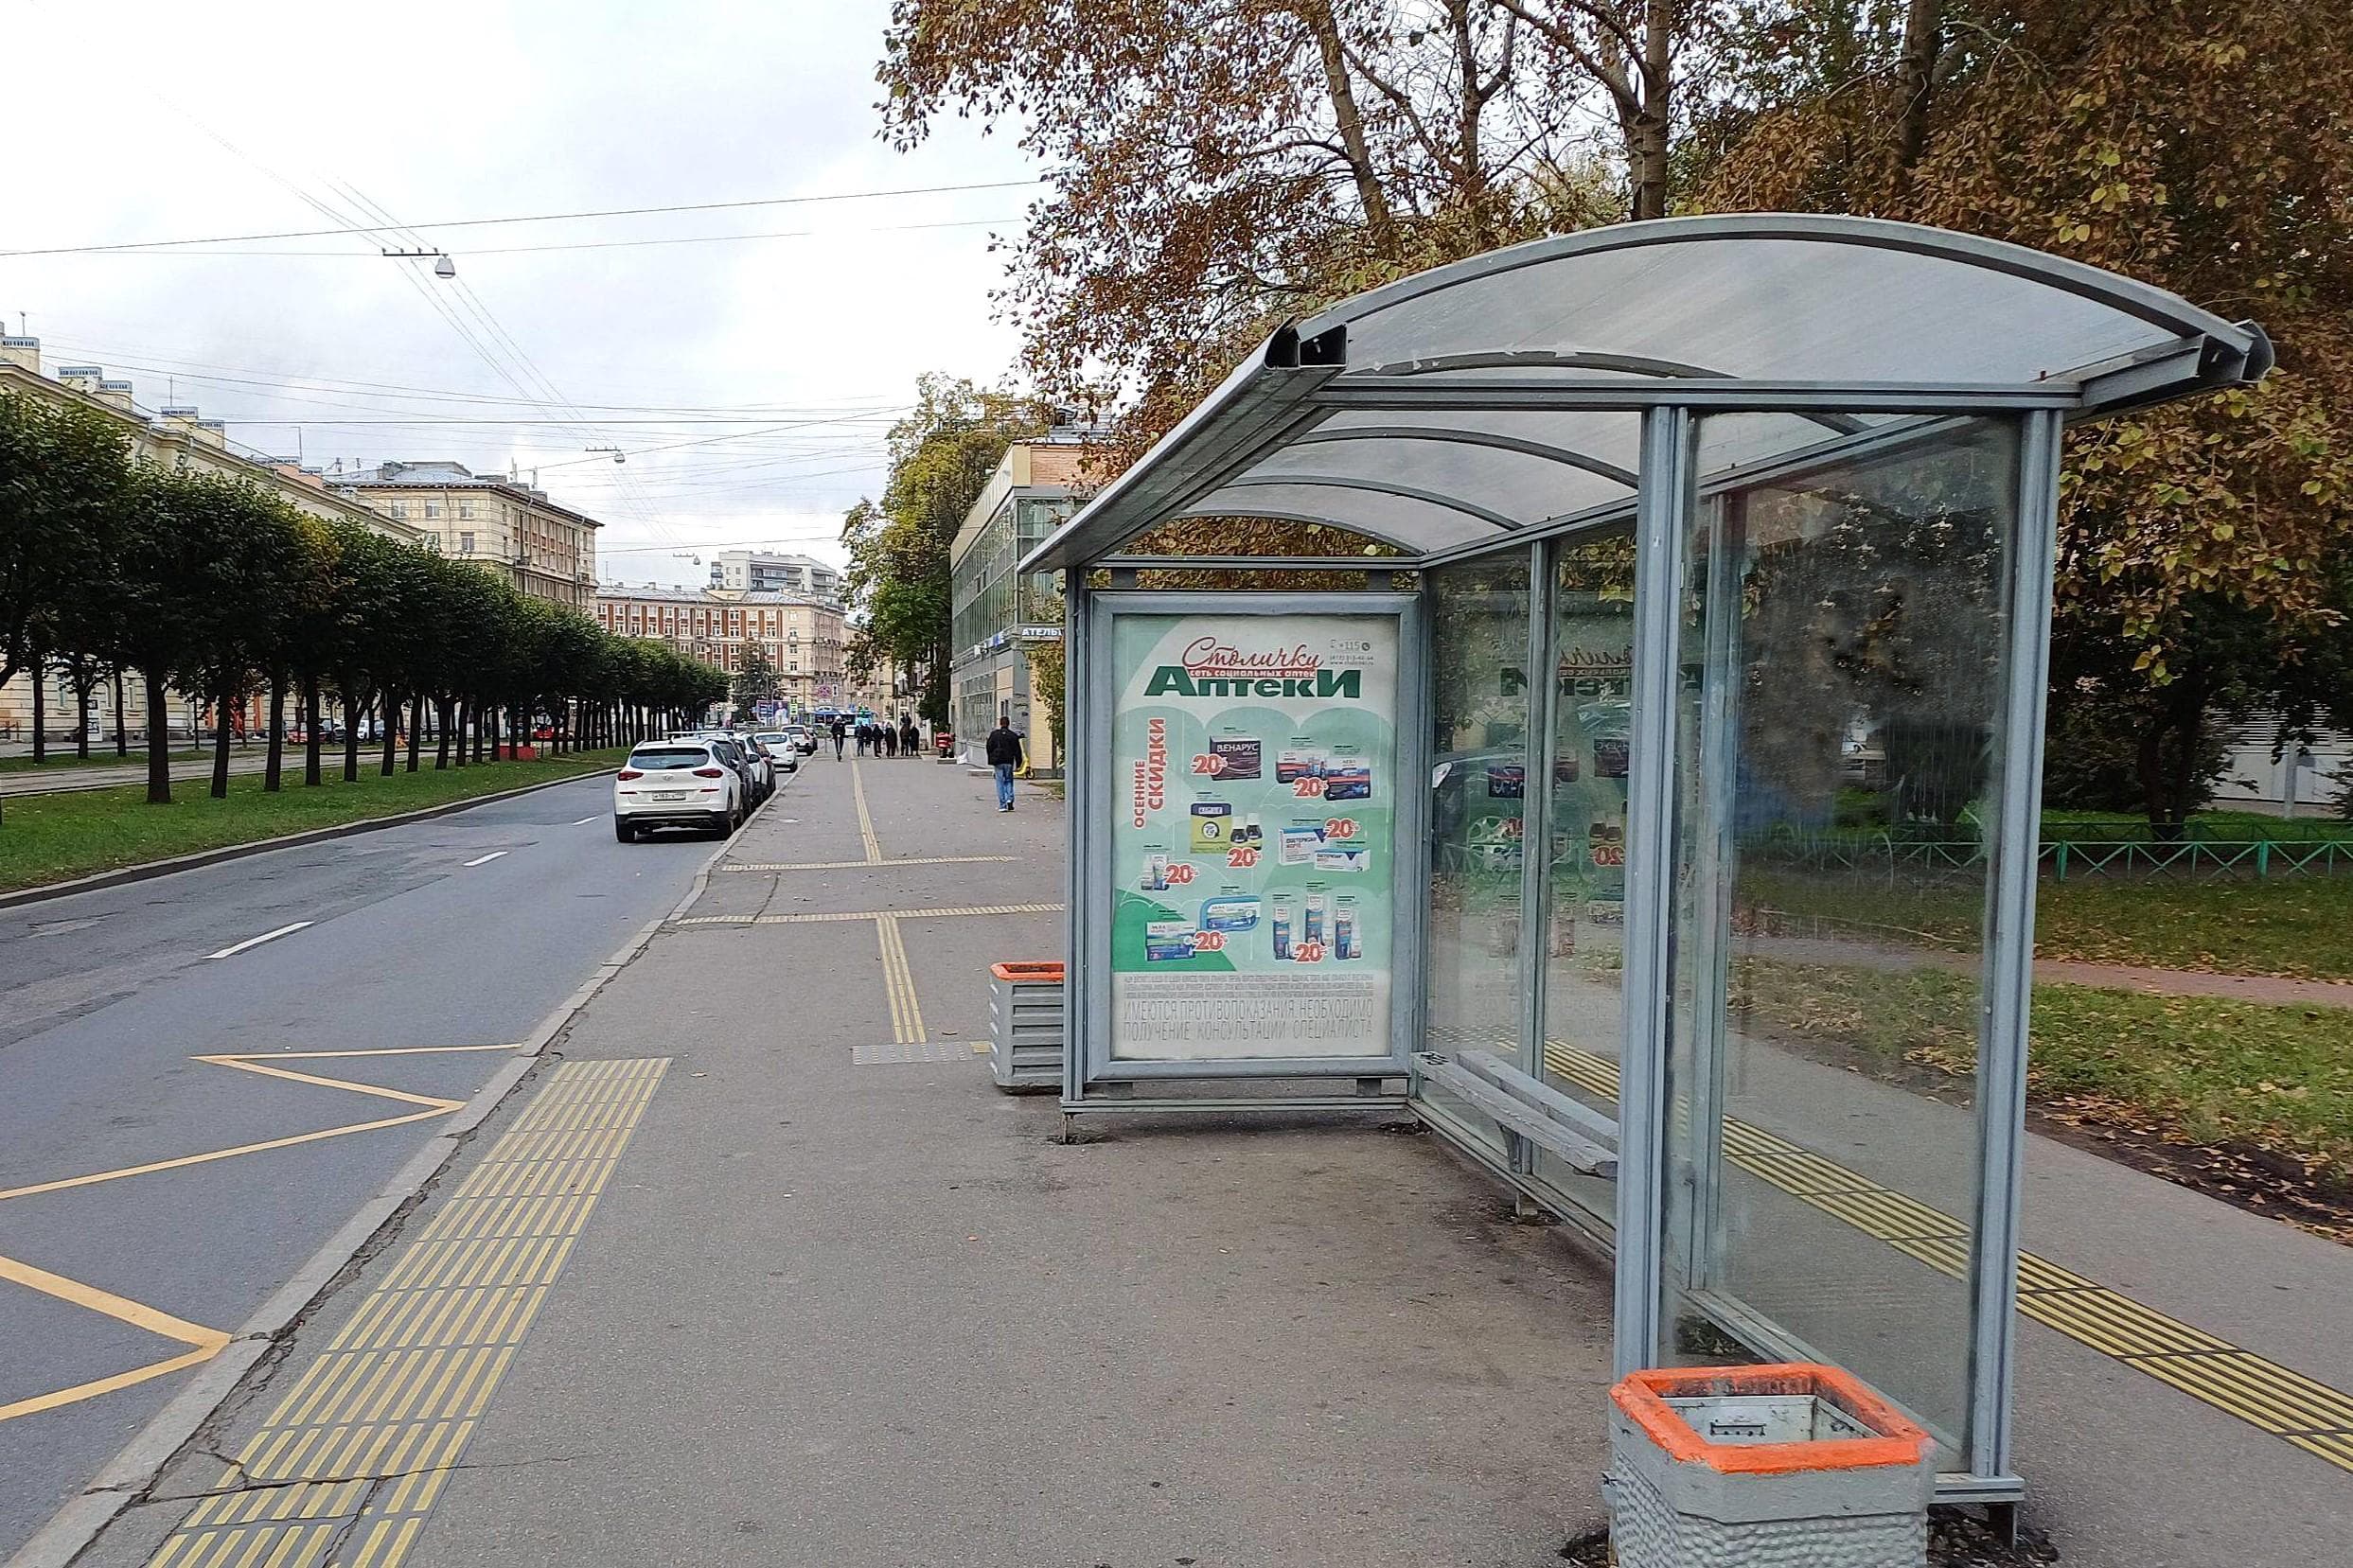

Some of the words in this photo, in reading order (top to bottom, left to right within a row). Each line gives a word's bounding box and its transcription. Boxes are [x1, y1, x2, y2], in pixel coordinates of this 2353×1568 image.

[1183, 636, 1324, 667] Столички
[1214, 670, 1282, 678] социальных
[1216, 743, 1259, 752] ВЕНАРУС
[1148, 718, 1166, 810] СКИДКИ
[1134, 761, 1145, 827] ОСЕННИЕ
[1123, 1000, 1176, 1020] ИМЕЮТСЯ
[1300, 998, 1372, 1019] НЕОБХОДИМО
[1123, 1021, 1190, 1041] ПОЛУЧЕНИЕ
[1197, 1021, 1285, 1040] КОНСУЛЬТАЦИИ
[1294, 1019, 1371, 1039] СПЕЦИАЛИСТА
